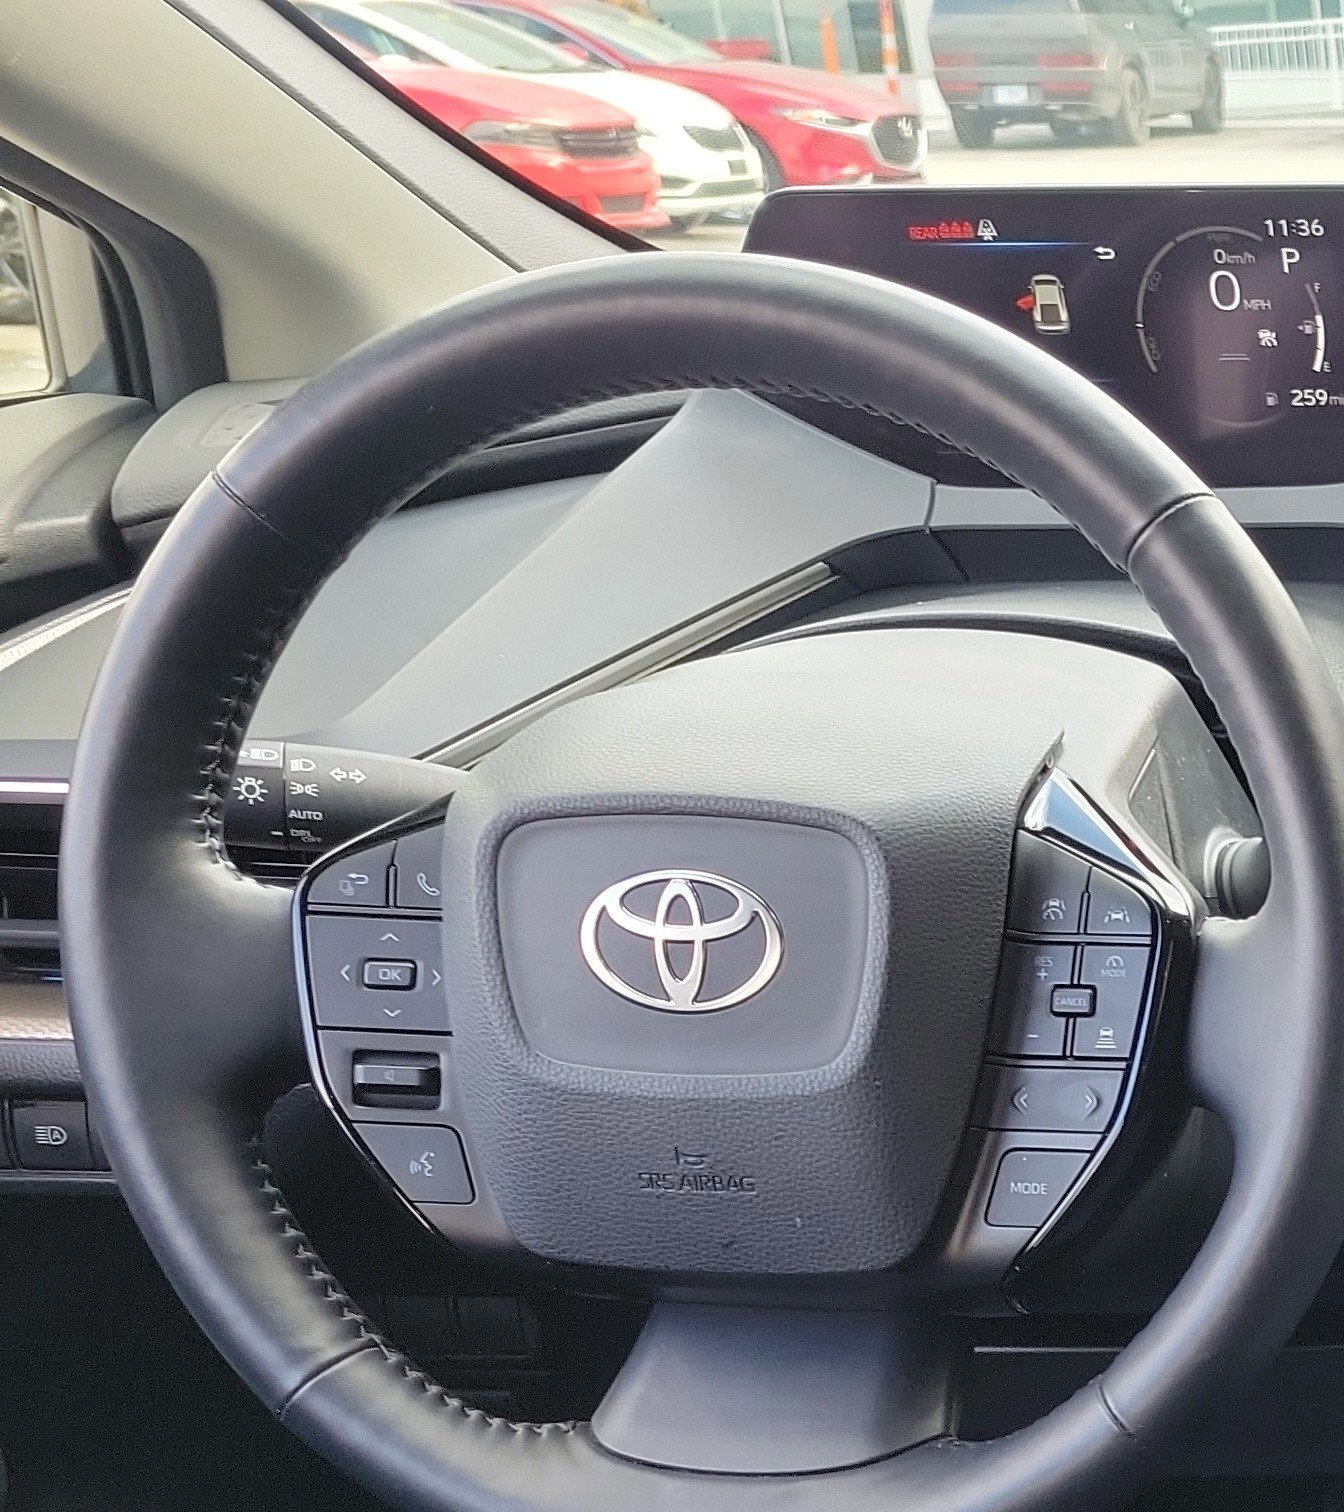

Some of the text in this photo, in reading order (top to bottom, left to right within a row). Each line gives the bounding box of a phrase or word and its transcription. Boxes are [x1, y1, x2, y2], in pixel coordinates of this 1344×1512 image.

[1263, 219, 1325, 237] 11:36
[1281, 248, 1300, 273] P
[1209, 270, 1241, 311] 0
[1313, 282, 1321, 293] F
[1242, 299, 1272, 310] MPH
[1323, 361, 1332, 372] E
[287, 809, 323, 820] AUTO
[378, 968, 403, 981] OK
[1009, 1181, 1049, 1196] MODE
